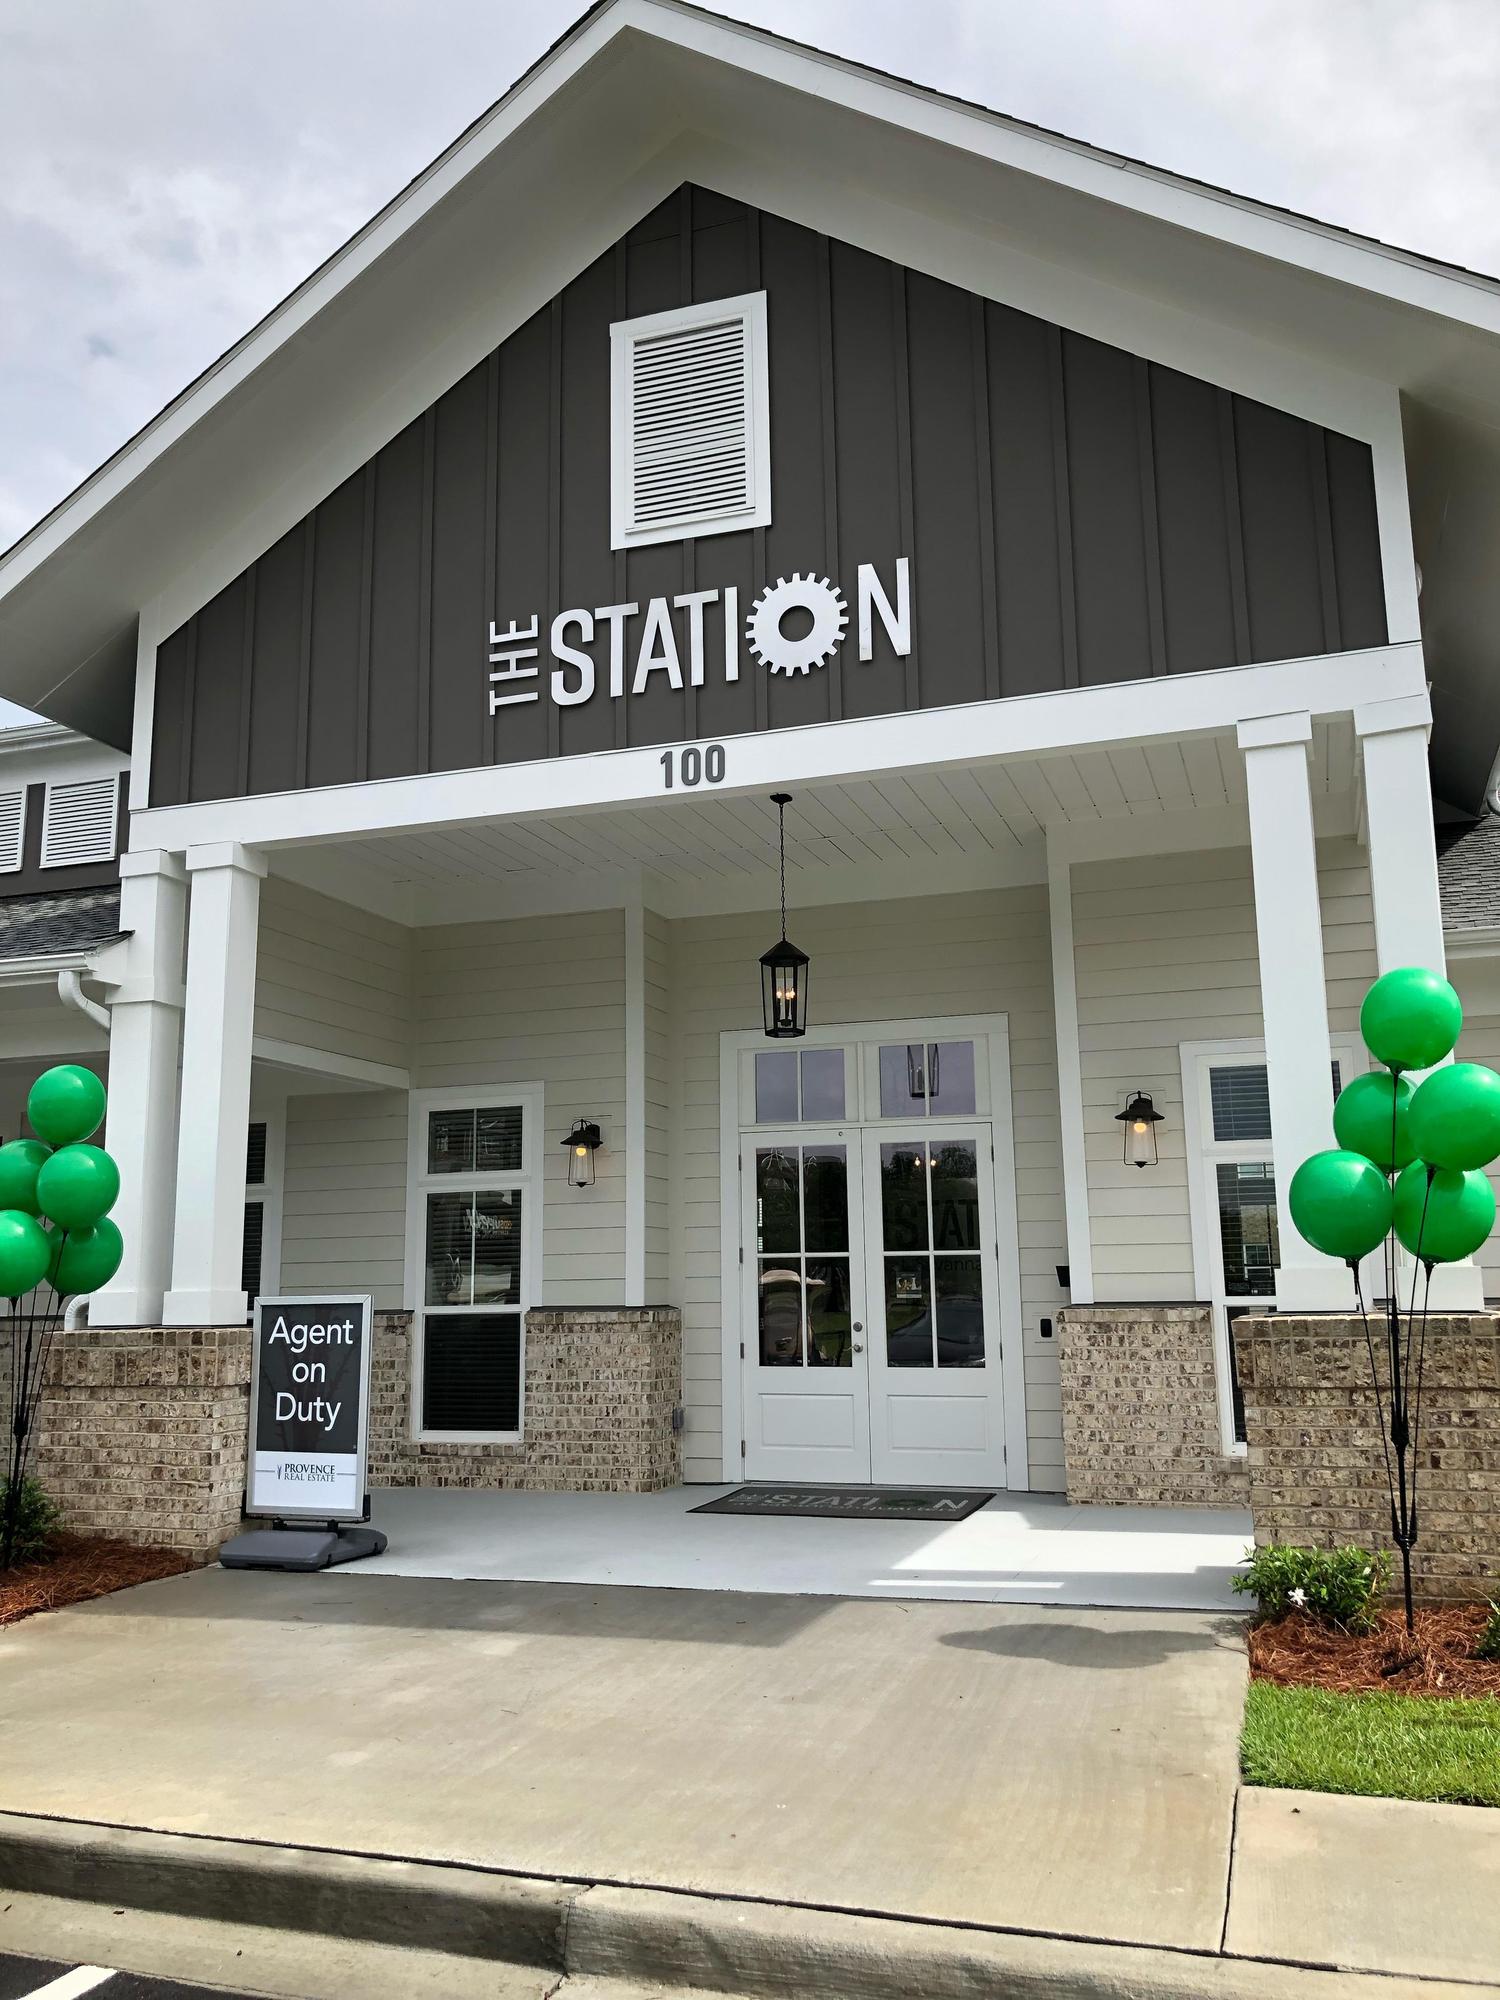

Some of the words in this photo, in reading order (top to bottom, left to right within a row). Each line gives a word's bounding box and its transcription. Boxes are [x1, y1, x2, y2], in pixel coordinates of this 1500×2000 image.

[489, 614, 538, 715] THE
[551, 557, 911, 706] STATION
[660, 744, 726, 788] 100
[269, 1316, 353, 1353] Agent
[292, 1362, 326, 1383] on
[275, 1392, 342, 1431] Duty
[284, 1463, 336, 1475] PROVENCE
[284, 1473, 305, 1481] REAL
[307, 1473, 336, 1482] ESTATE
